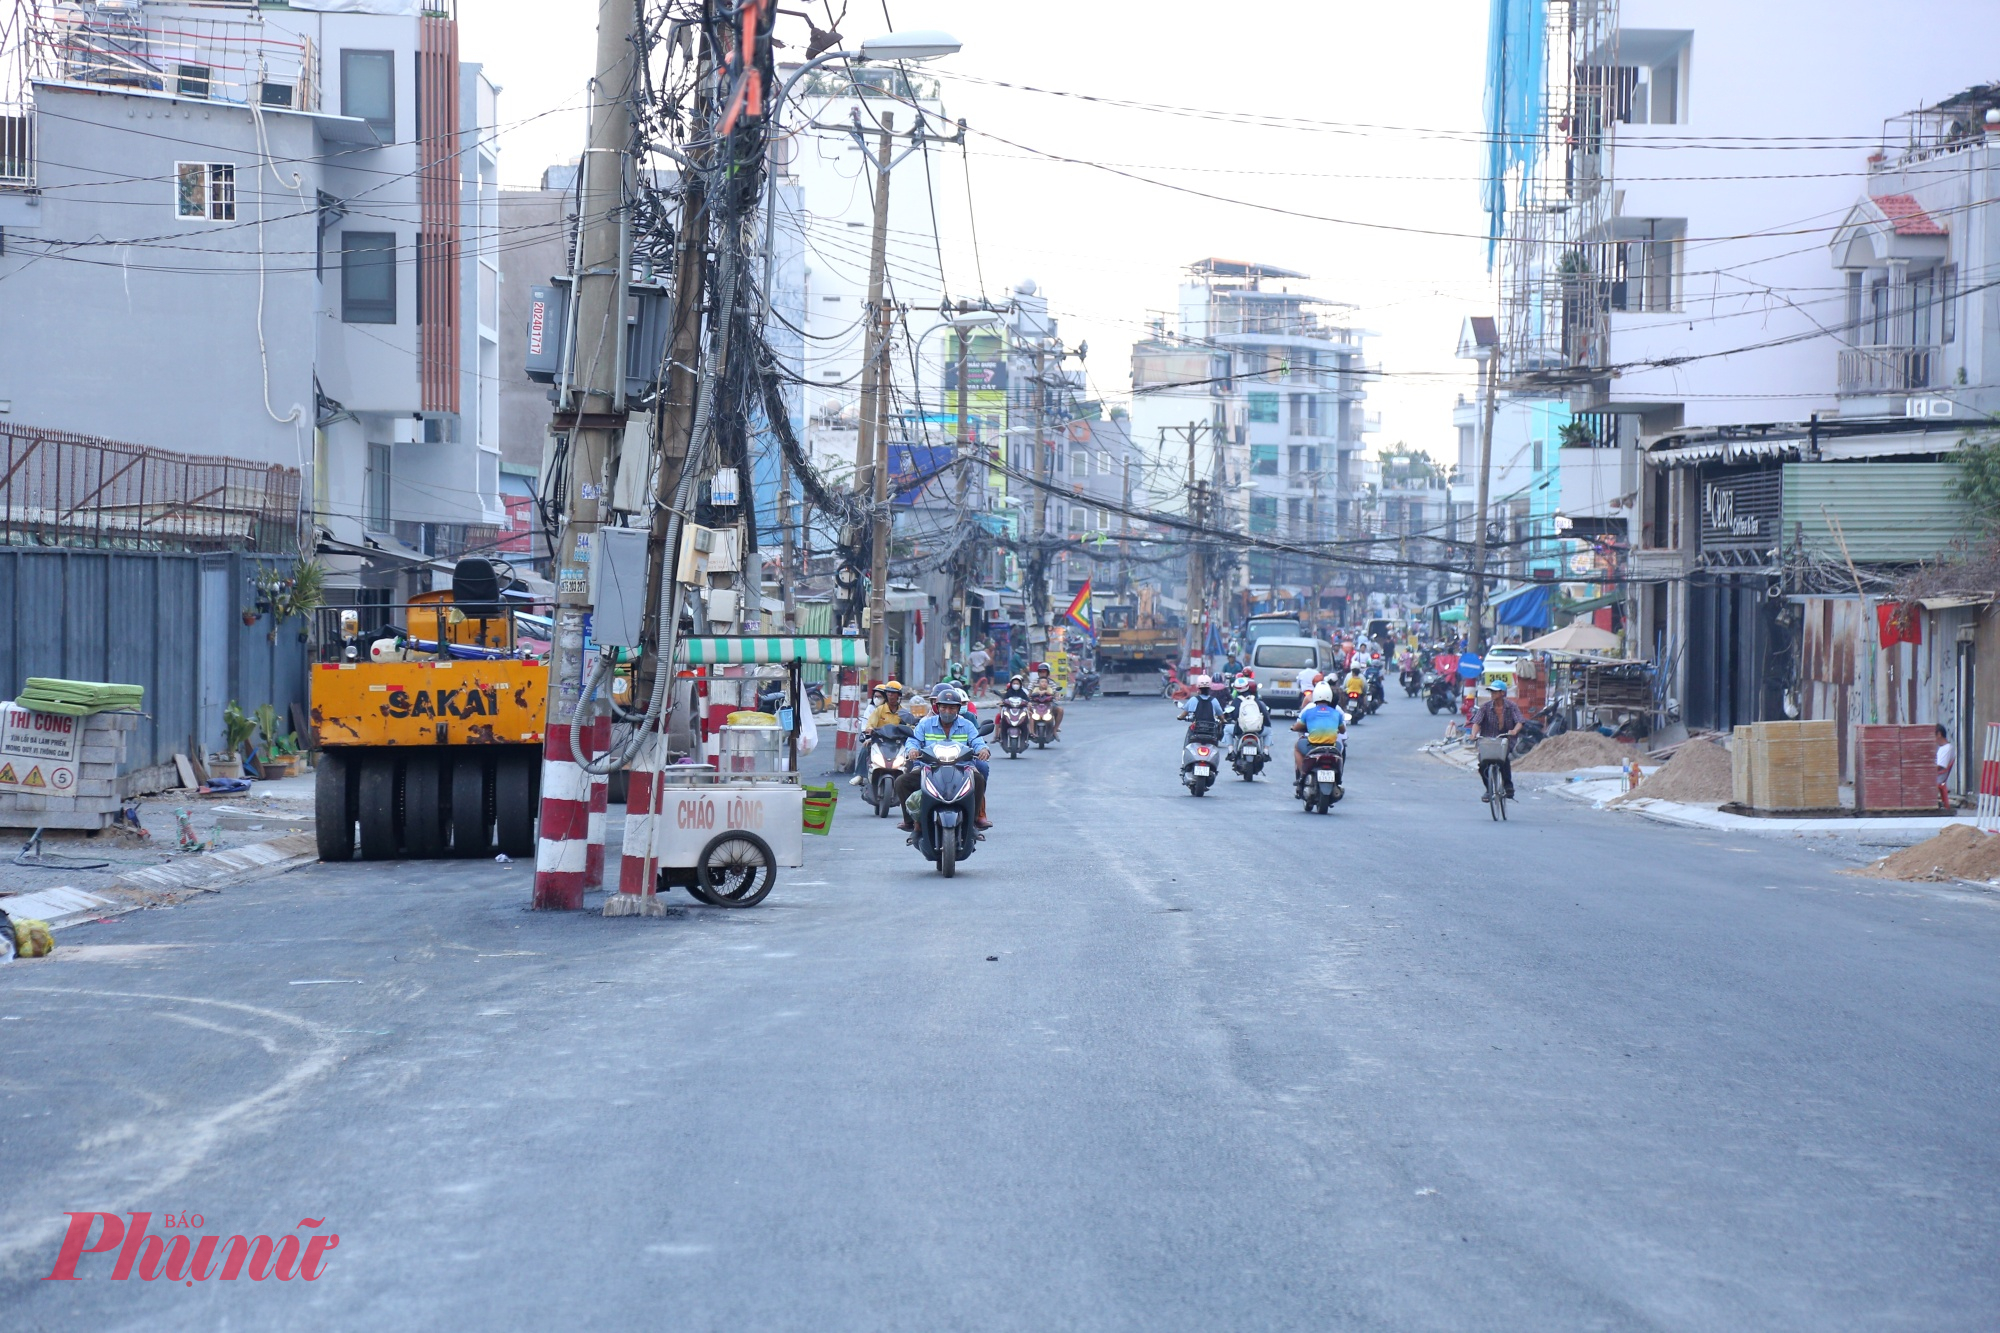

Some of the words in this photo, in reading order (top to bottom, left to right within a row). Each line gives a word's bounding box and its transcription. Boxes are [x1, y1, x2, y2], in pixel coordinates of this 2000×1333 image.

[531, 302, 544, 354] 202401717
[1489, 674, 1508, 682] 355
[388, 689, 498, 719] SAKAI
[10, 711, 30, 729] THI
[58, 773, 67, 783] 5
[677, 794, 715, 830] CHÁO
[727, 795, 764, 829] LÒNG
